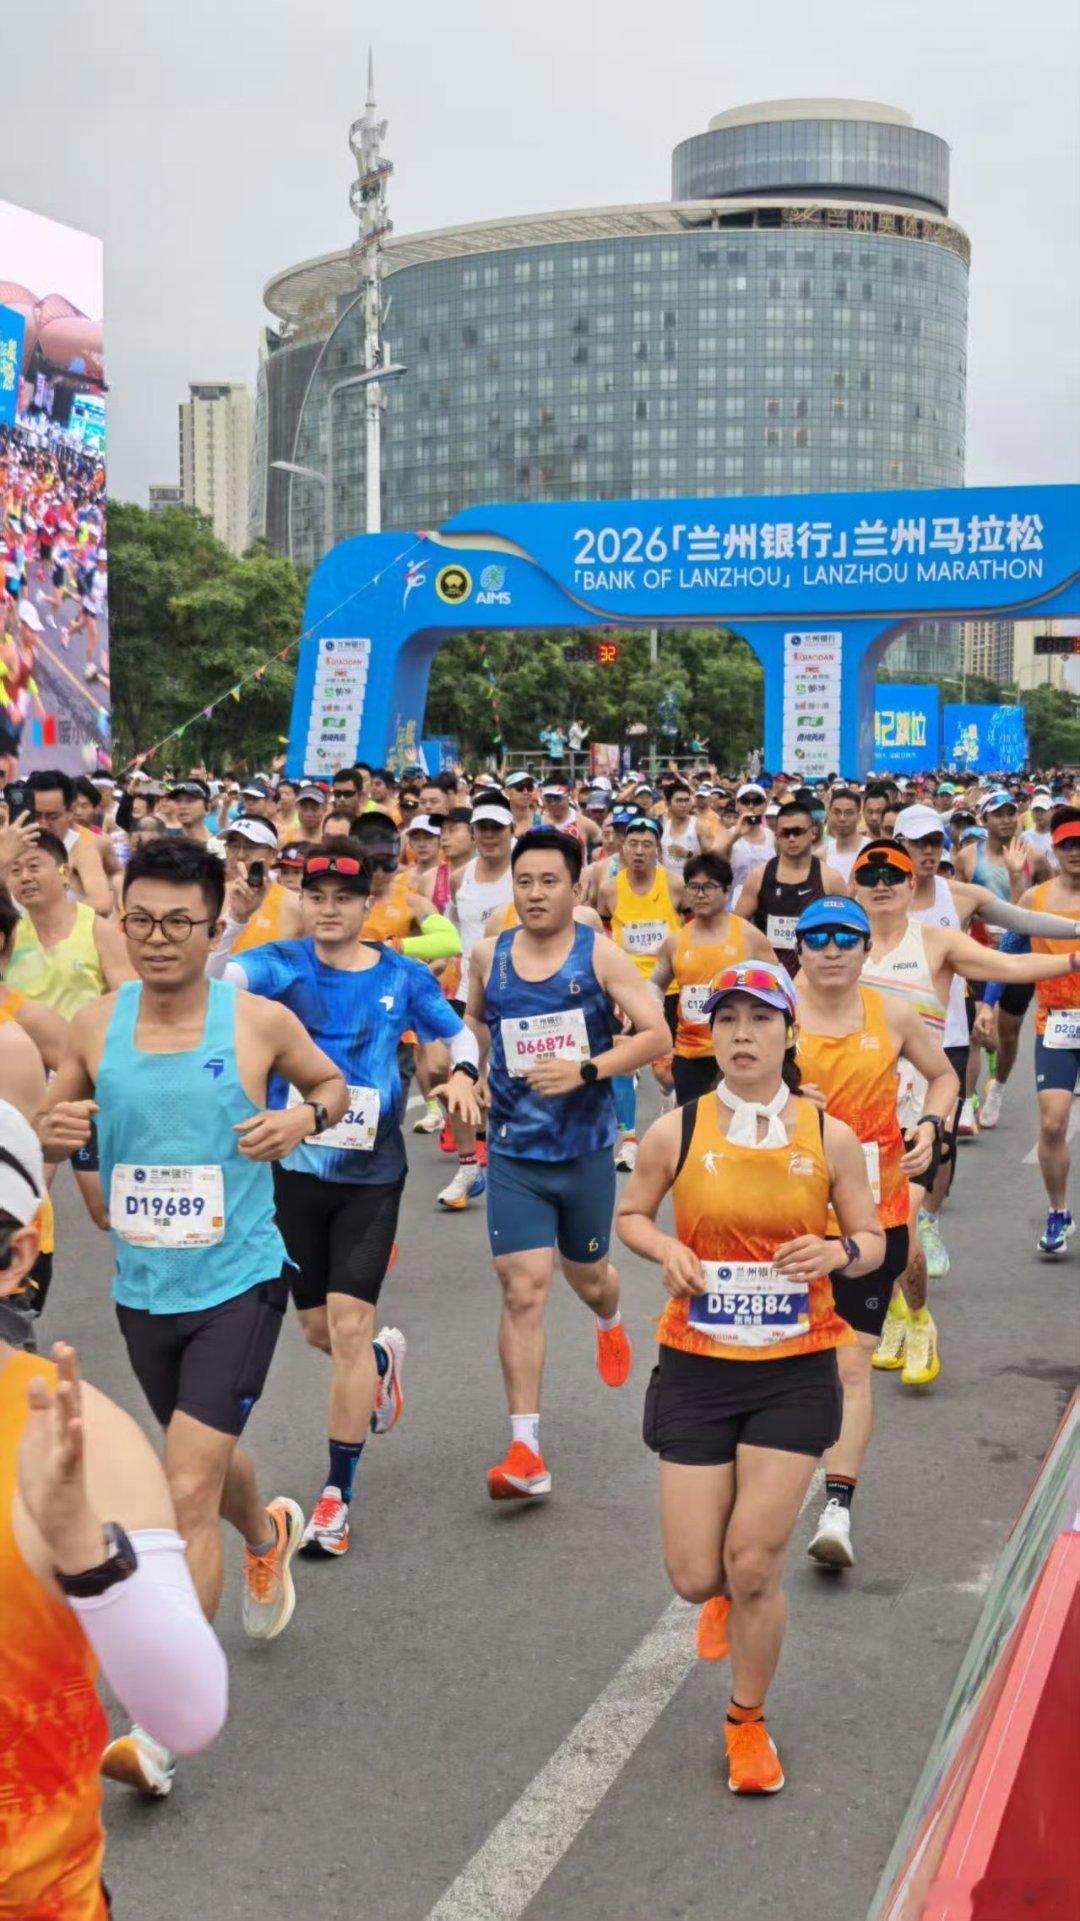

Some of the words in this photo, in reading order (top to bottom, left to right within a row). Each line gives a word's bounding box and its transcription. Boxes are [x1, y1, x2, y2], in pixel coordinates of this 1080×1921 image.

[573, 514, 1044, 565] 2026「兰州银行」兰州马拉松
[643, 569, 672, 588] OF
[803, 562, 908, 585] LANZHOU
[917, 558, 1043, 582] MARATHON
[475, 591, 512, 605] AIMS
[600, 646, 616, 662] 32
[892, 961, 919, 971] HOKA
[516, 1034, 576, 1055] D66874
[126, 1196, 206, 1217] D19689
[707, 1294, 792, 1315] D52884
